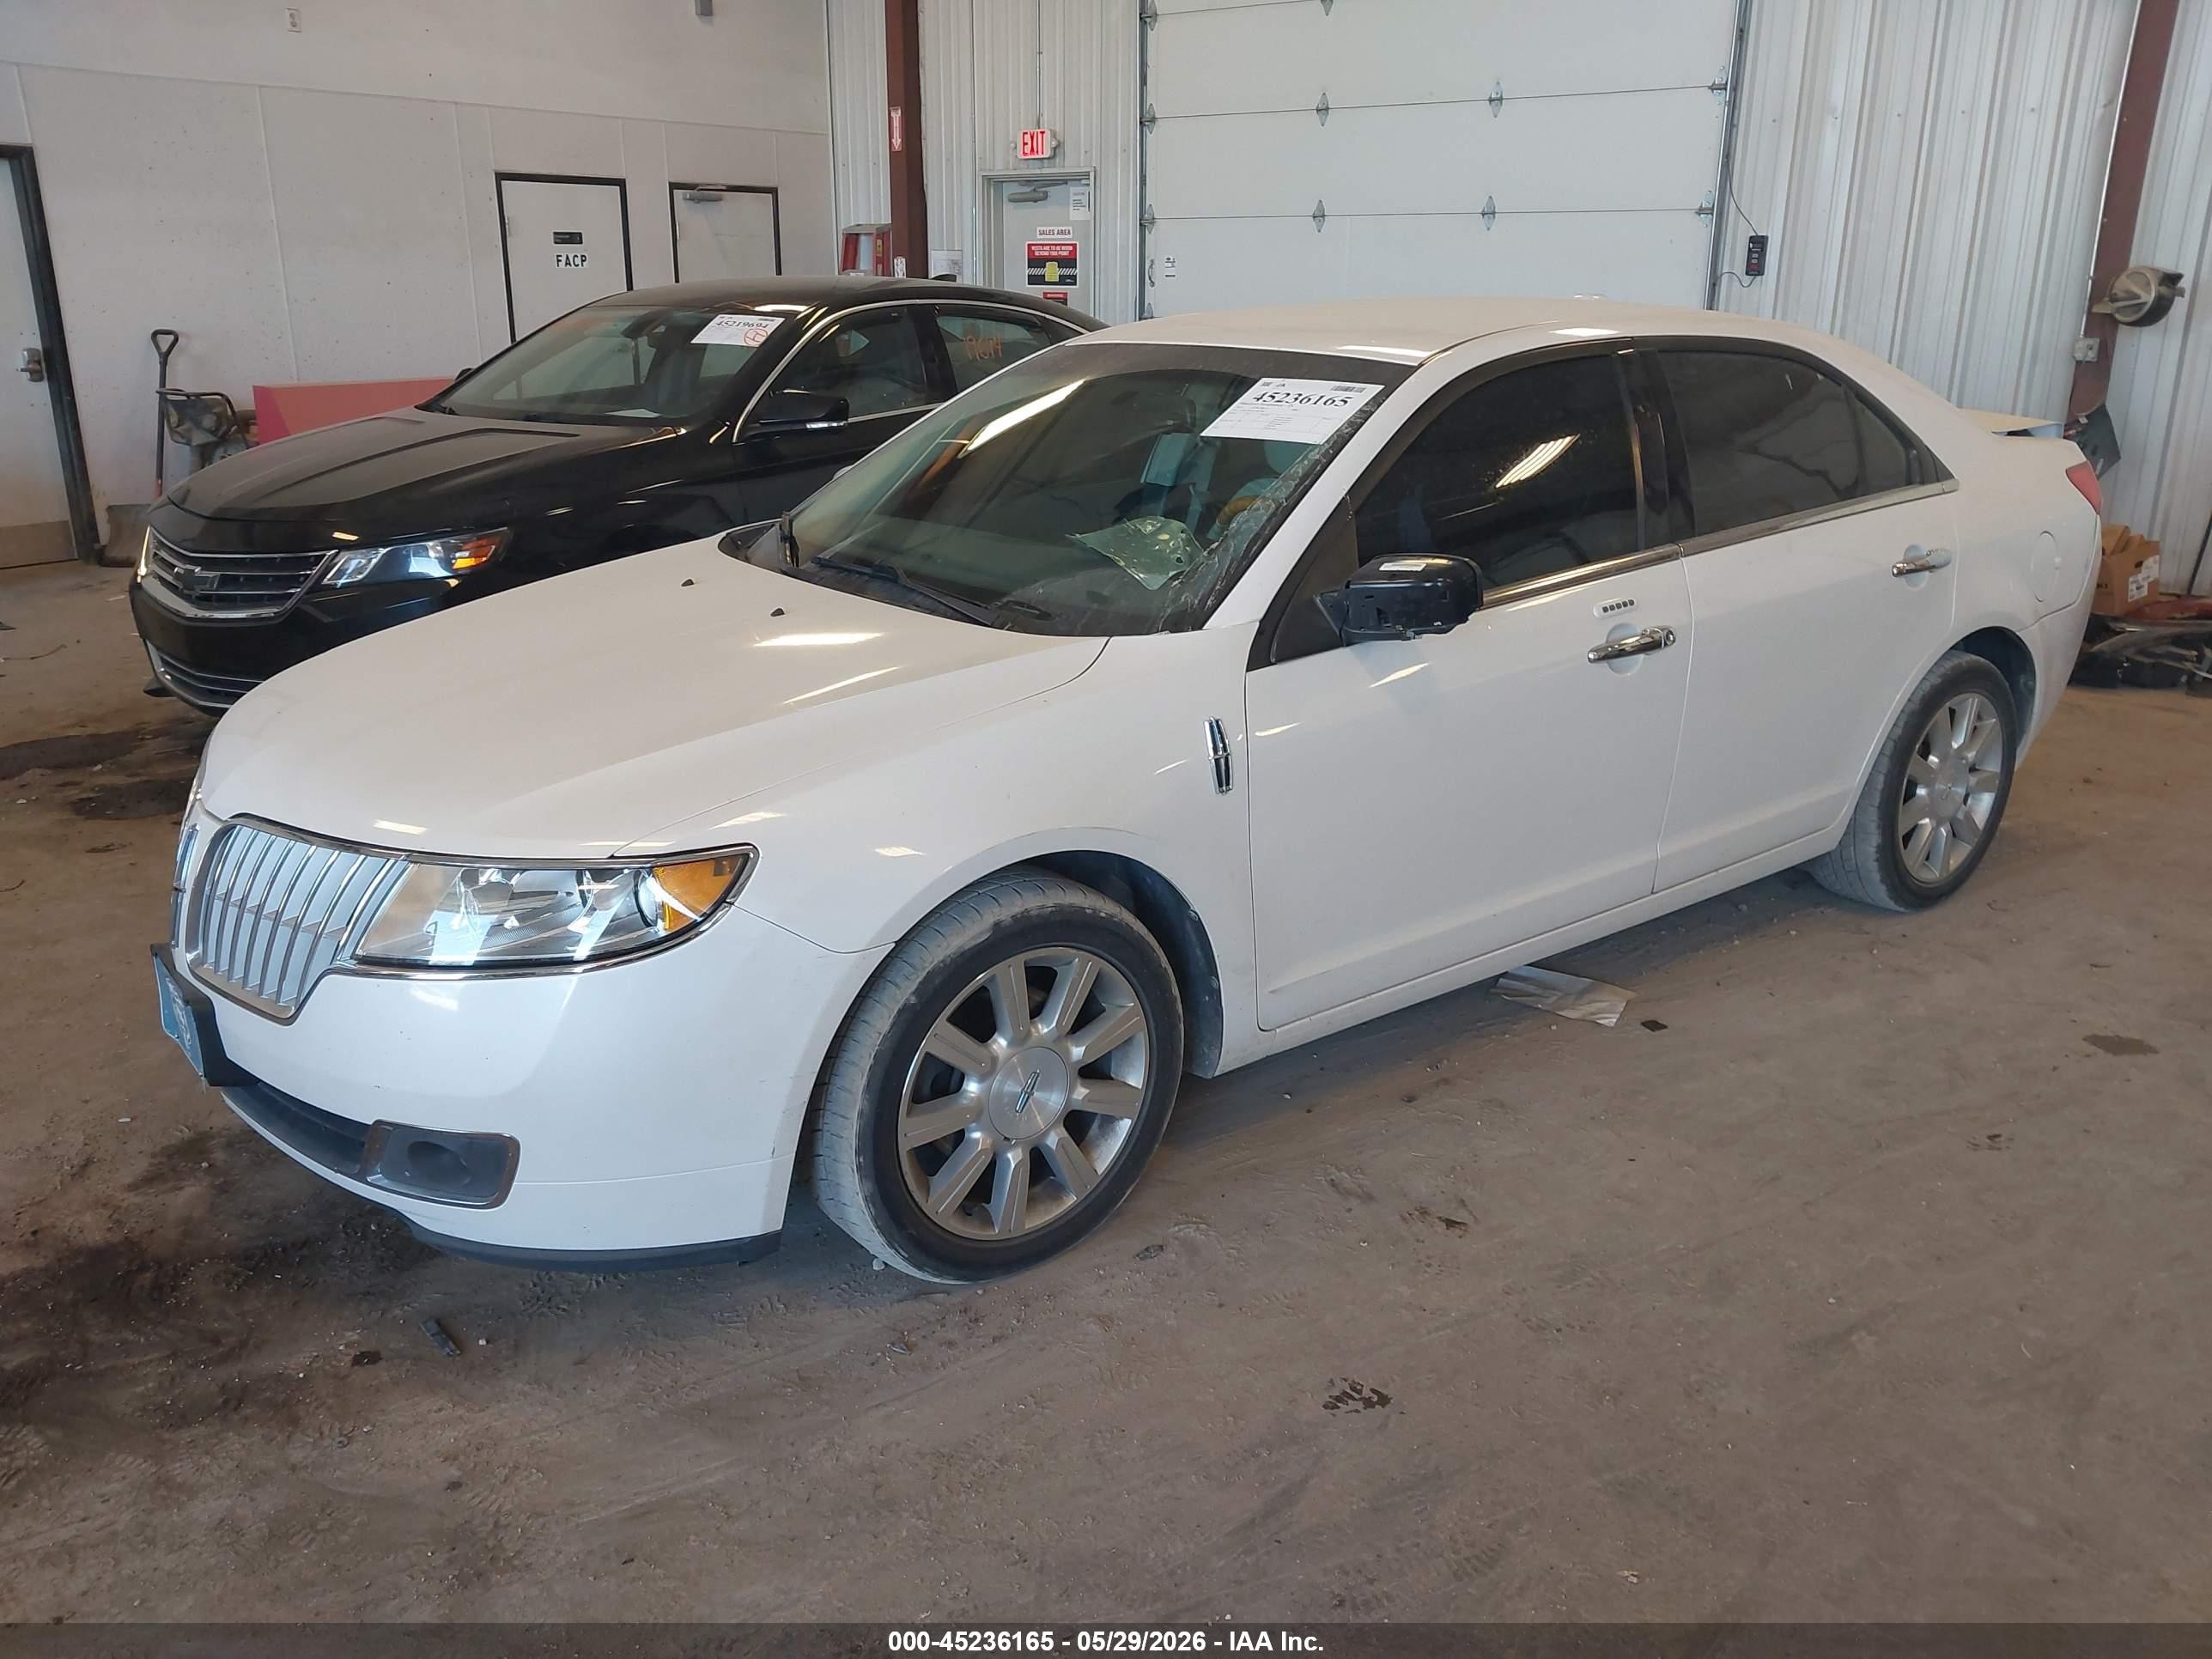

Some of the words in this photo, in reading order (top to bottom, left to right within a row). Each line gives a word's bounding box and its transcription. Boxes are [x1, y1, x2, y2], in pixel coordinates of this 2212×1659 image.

[1022, 131, 1046, 156] EXIT
[556, 253, 587, 268] FACP
[1253, 392, 1353, 407] 45236165
